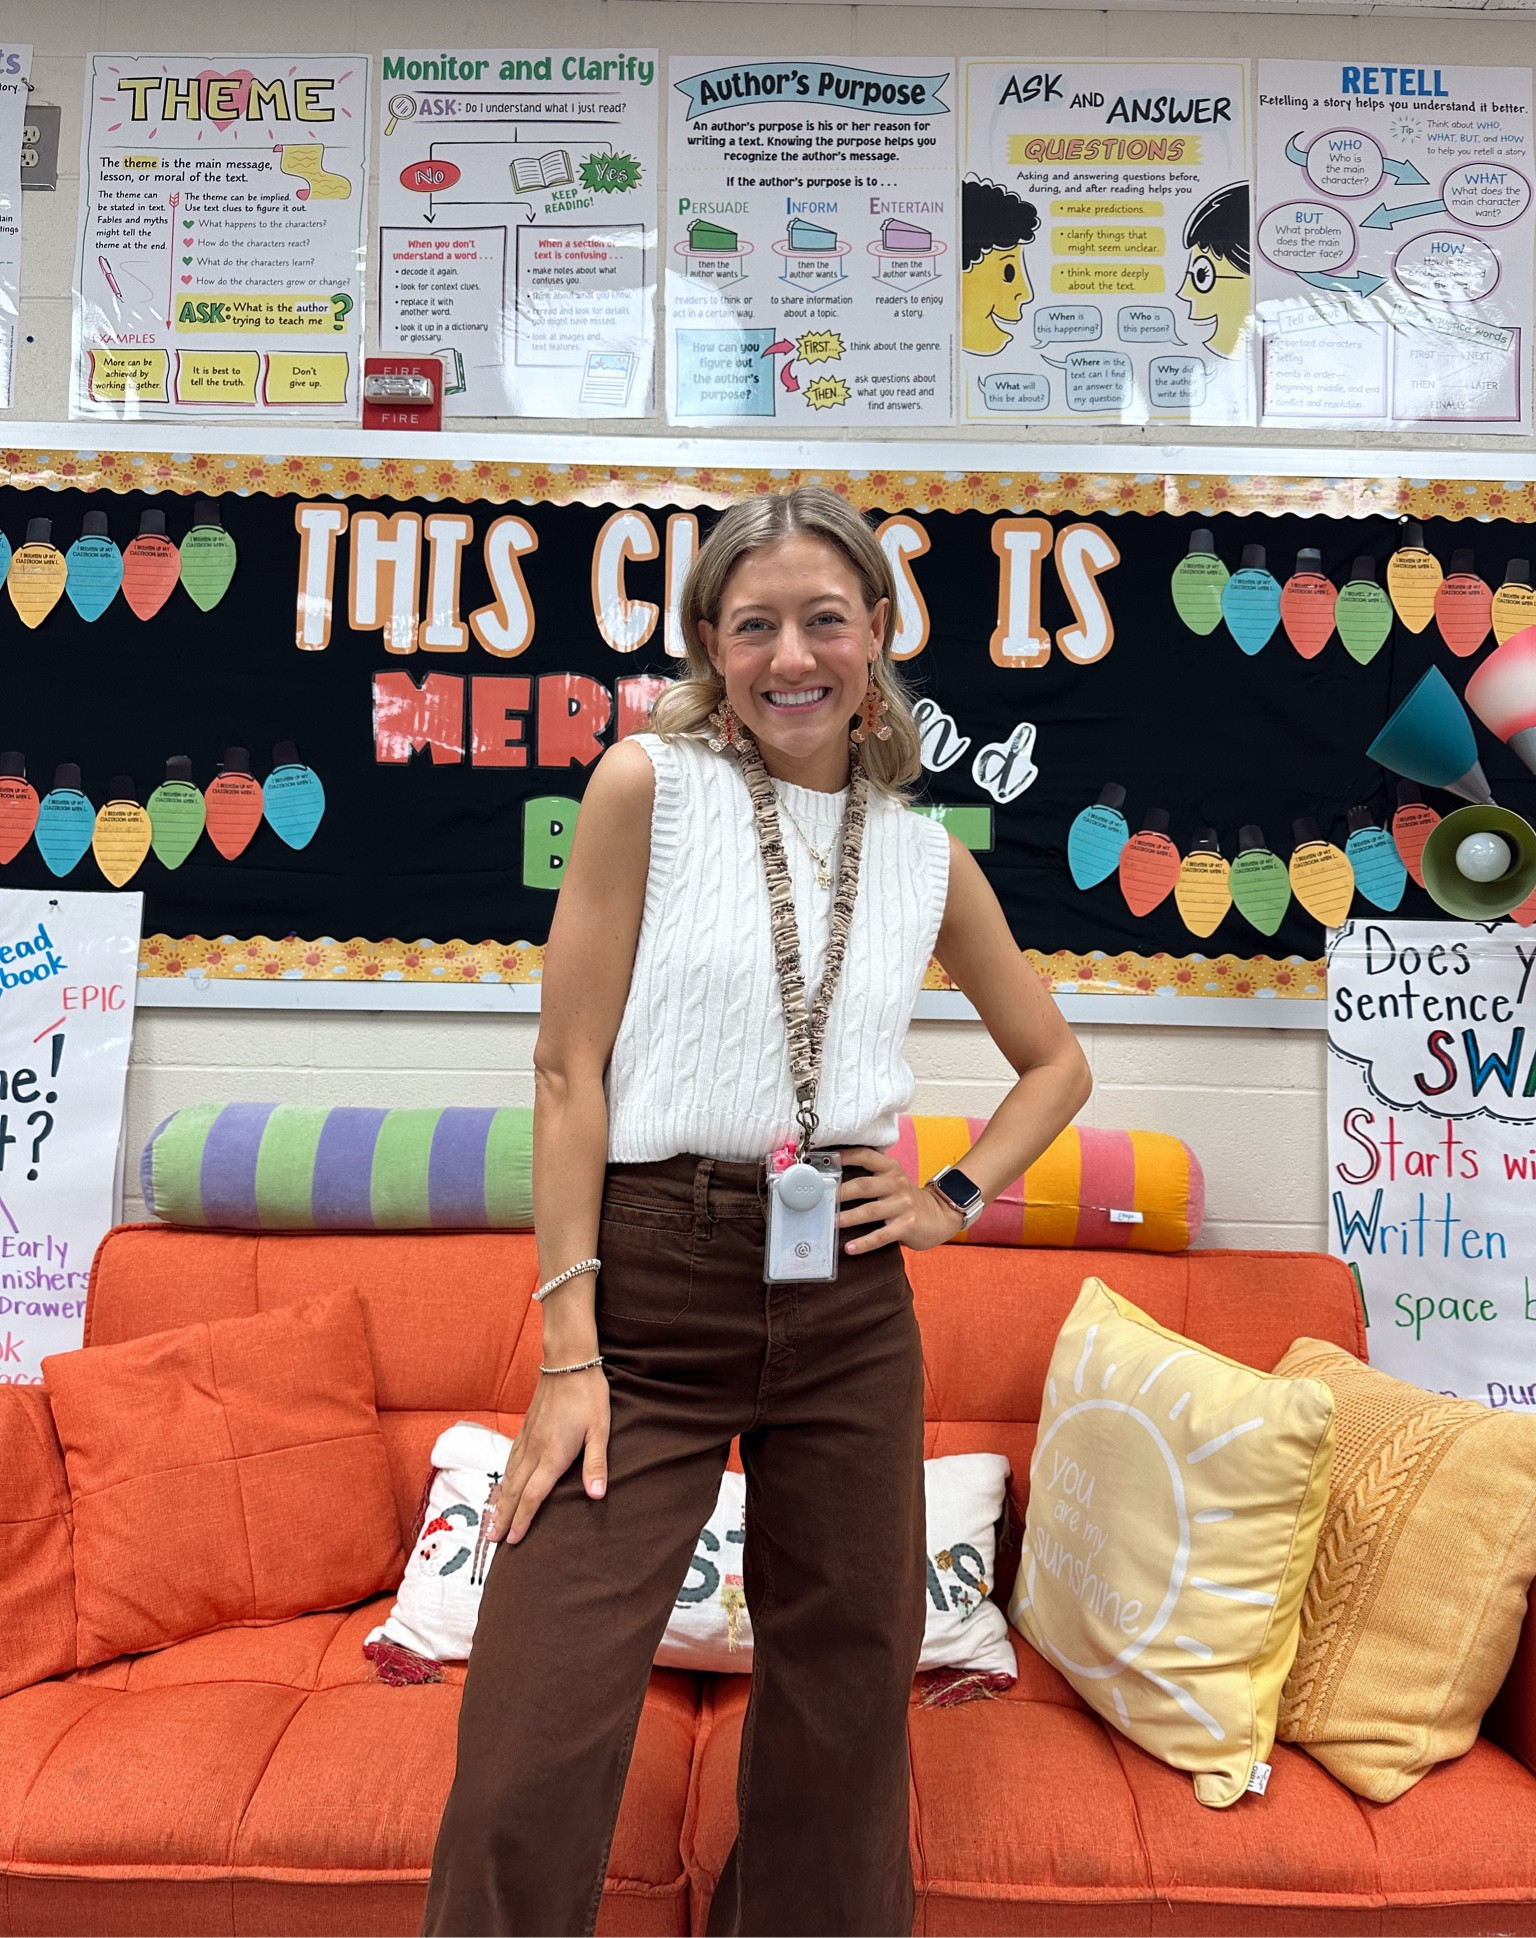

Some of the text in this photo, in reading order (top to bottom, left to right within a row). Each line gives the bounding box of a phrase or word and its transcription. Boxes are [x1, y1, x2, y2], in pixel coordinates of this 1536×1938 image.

[382, 53, 654, 86] Monitor and Clarify
[700, 70, 926, 106] Author's Purpose
[1342, 66, 1448, 97] RETELL
[118, 77, 336, 122] THEME
[999, 73, 1232, 124] ASK AND ANSWER
[1259, 95, 1308, 110] Retelling
[1323, 97, 1351, 111] story
[1355, 97, 1384, 112] helps
[1388, 101, 1408, 112] you
[1412, 99, 1476, 112] understand
[1480, 103, 1487, 112] it
[1491, 102, 1528, 113] better.
[418, 99, 626, 115] ASK: Do I understand what I just read?
[692, 121, 708, 131] An
[710, 122, 755, 131] author's
[758, 123, 803, 133] purpose
[806, 120, 814, 131] is
[817, 120, 833, 131] his
[851, 121, 870, 131] her
[873, 123, 910, 131] reason
[913, 121, 930, 131] for
[1400, 125, 1414, 136] Tip
[1024, 138, 1185, 162] QUESTIONS
[1328, 139, 1362, 151] WHO
[99, 157, 272, 171] The theme is the main message,
[723, 151, 899, 163] recognize the author's message.
[1328, 153, 1362, 163] Who is
[100, 170, 134, 183] lesson,
[154, 171, 185, 181] moral
[189, 172, 201, 182] of
[204, 171, 221, 182] the
[225, 173, 248, 182] text.
[596, 161, 628, 183] Yes
[1325, 164, 1364, 173] the main
[415, 170, 445, 185] No
[1016, 171, 1200, 183] Asking and answering questions before,
[1320, 175, 1369, 185] character?
[1464, 173, 1508, 185] WHAT
[552, 188, 578, 201] KEEP
[1028, 183, 1192, 196] during, and after reading helps you
[545, 198, 594, 214] READING!
[678, 198, 748, 215] PERSUADE
[786, 197, 837, 215] INFORM
[869, 197, 943, 215] ENTERTAIN
[1066, 203, 1144, 216] make predictions.
[198, 219, 222, 227] What
[224, 219, 256, 230] happens
[269, 220, 282, 228] the
[284, 219, 327, 228] characters?
[1295, 212, 1324, 224] BUT
[1431, 242, 1465, 255] HOW
[436, 268, 458, 277] again.
[430, 283, 458, 291] context
[179, 301, 231, 324] ASK:
[232, 302, 328, 312] What is the author
[232, 315, 260, 327] trying
[264, 316, 274, 325] to
[278, 315, 304, 325] teach
[1129, 312, 1152, 320] Who
[1123, 324, 1170, 335] this person?
[850, 341, 941, 352] think about the genre.
[292, 367, 317, 375] Don't
[384, 366, 420, 375] FIRE
[289, 379, 321, 389] give up.
[381, 414, 419, 424] FIRE
[295, 502, 1120, 668] THIS CLS IS
[372, 670, 675, 770] MER
[914, 702, 1032, 798] nd
[0, 922, 54, 964] ead
[1365, 926, 1471, 977] Does
[63, 985, 125, 1012] EPIC
[1334, 980, 1514, 1023] sentence
[1336, 1107, 1536, 1186] Starts wi
[1333, 1189, 1506, 1259] Written
[2, 1235, 68, 1268] Early
[2, 1266, 90, 1290] nishers
[1394, 1291, 1498, 1341] space
[1487, 1382, 1536, 1408] Dur
[1047, 1449, 1096, 1508] you
[1054, 1499, 1108, 1555] are my
[1034, 1527, 1143, 1635] sunshine
